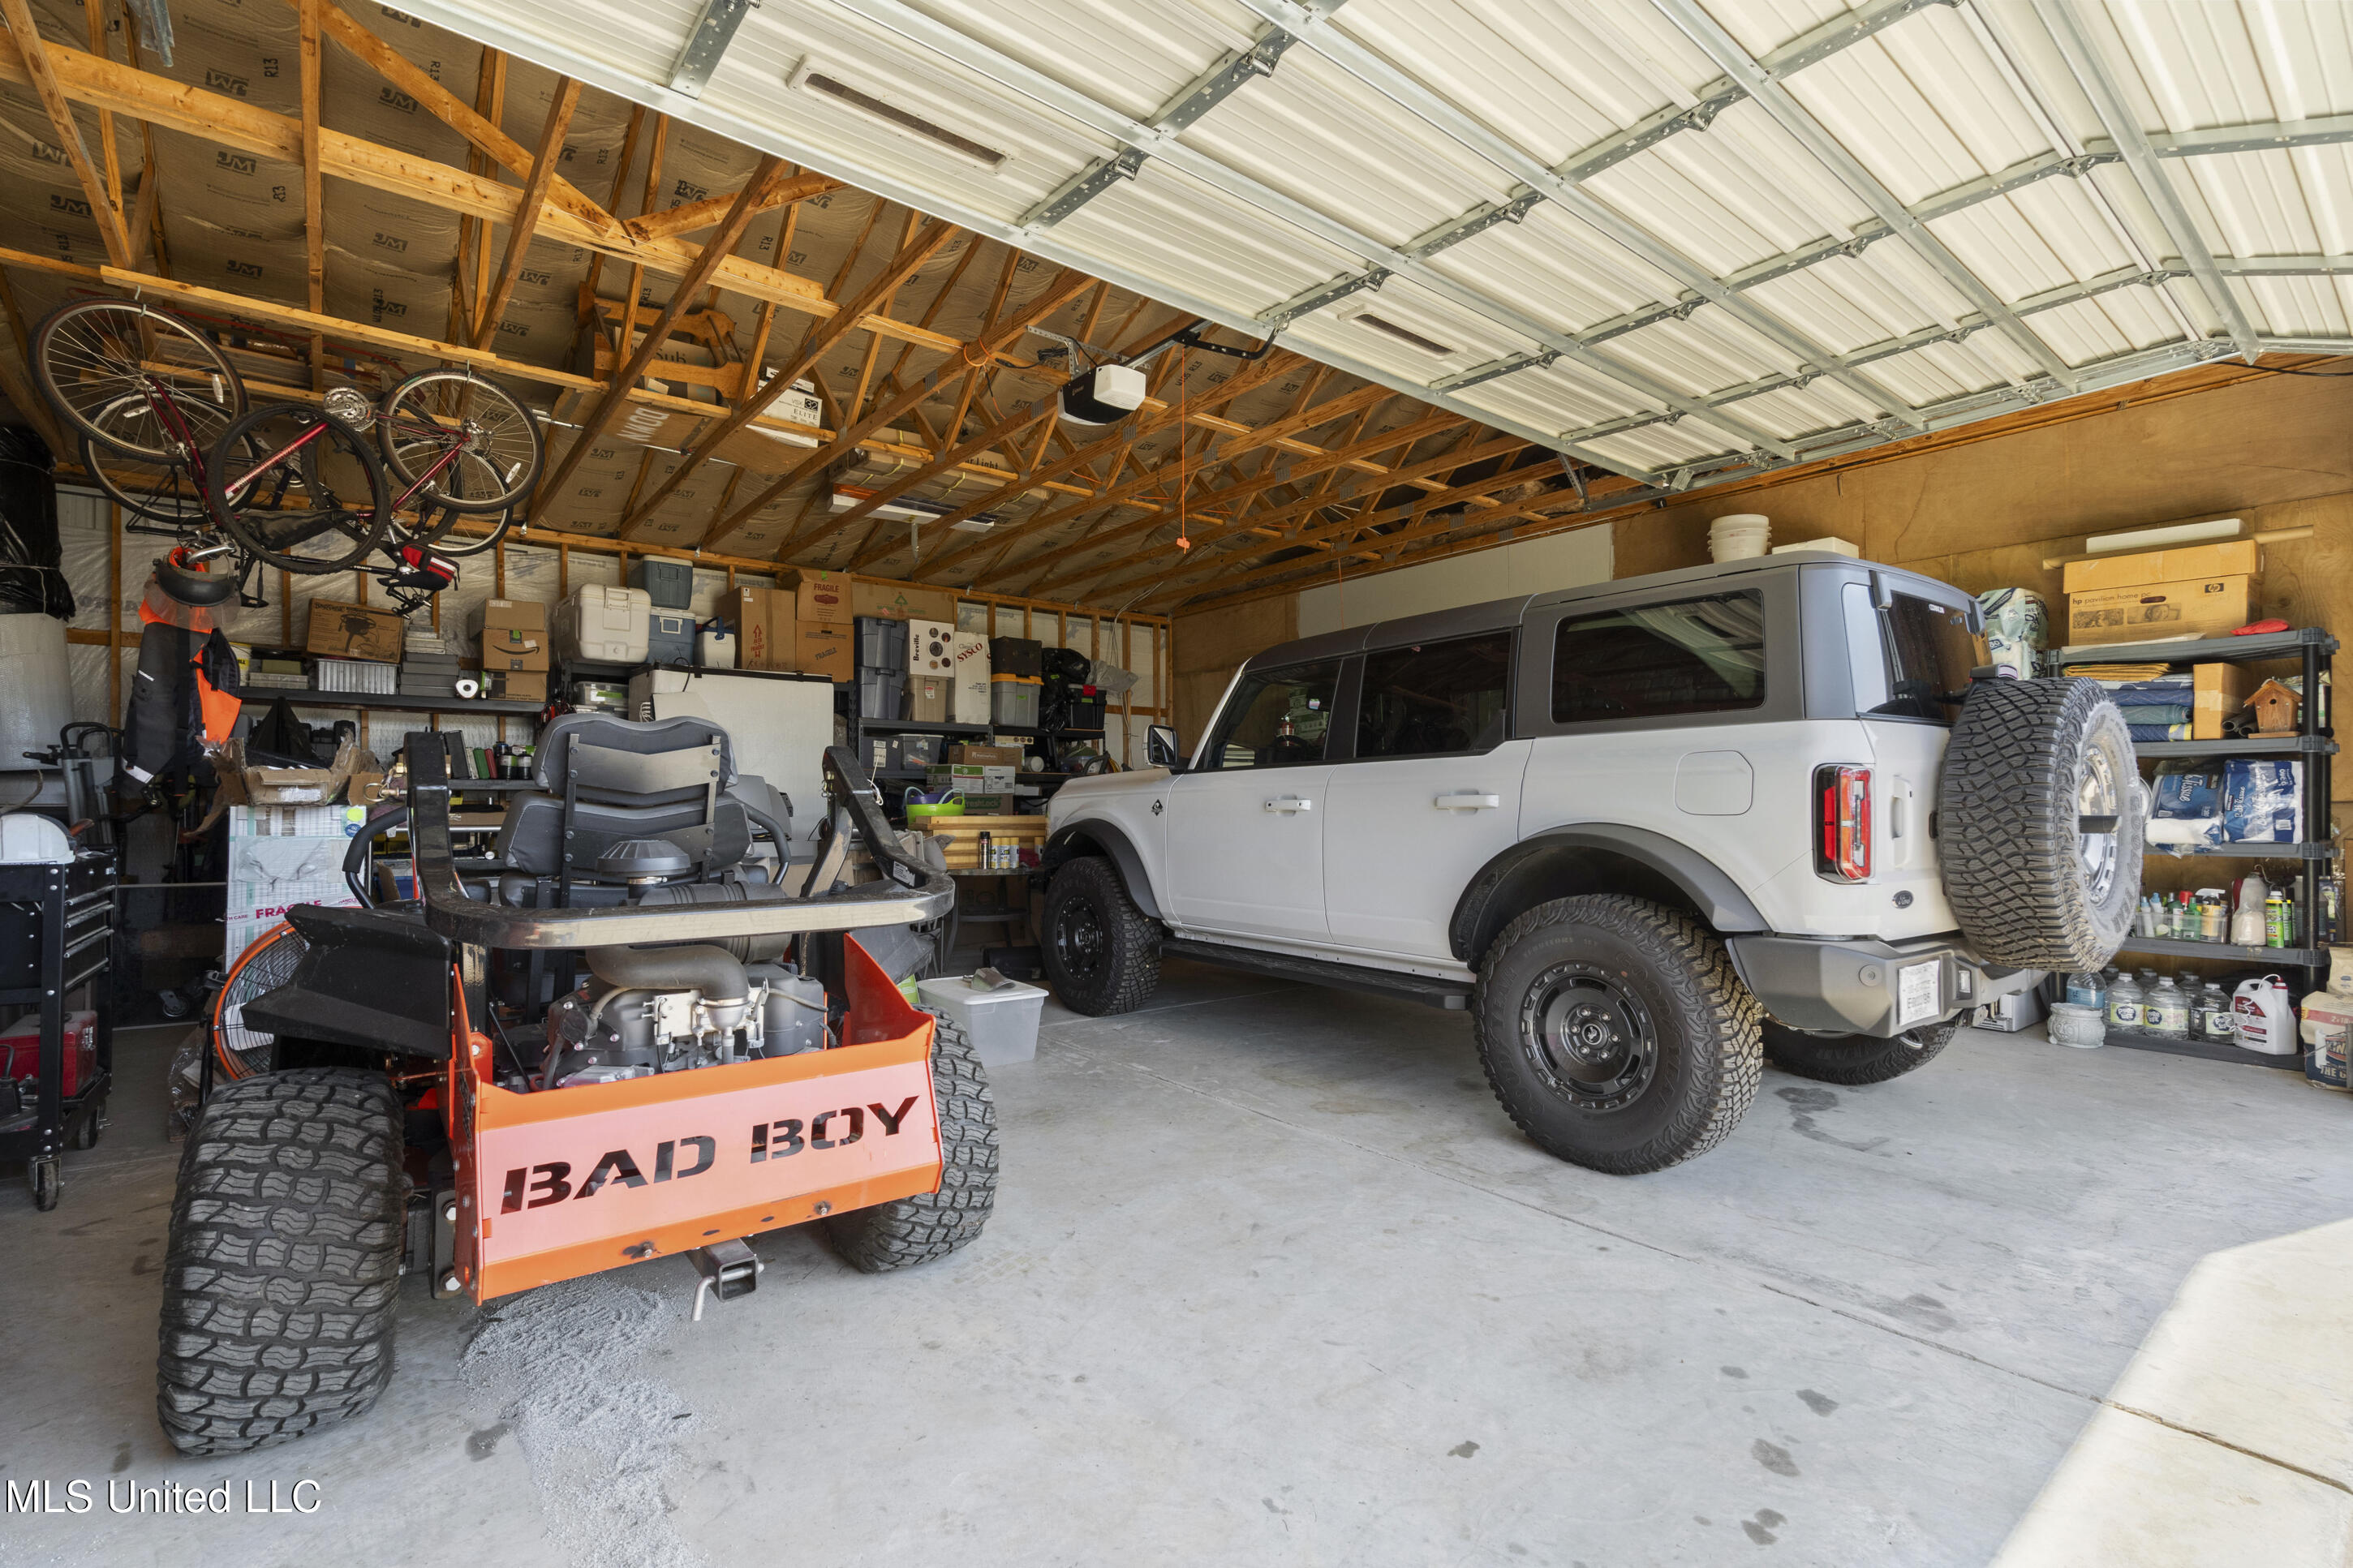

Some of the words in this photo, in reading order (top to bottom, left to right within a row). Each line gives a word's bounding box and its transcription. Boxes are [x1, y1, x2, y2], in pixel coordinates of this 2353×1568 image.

[264, 58, 279, 78] R13
[205, 69, 248, 96] JM
[379, 87, 419, 112] JM
[216, 151, 256, 172] JM
[50, 195, 91, 217] JM
[372, 232, 408, 251] JM
[759, 235, 773, 251] R13
[226, 260, 263, 277] JM
[518, 271, 552, 285] JM
[500, 321, 530, 337] JM
[805, 398, 819, 411] 32
[794, 409, 818, 420] ELITE
[590, 448, 614, 460] JM
[814, 582, 839, 593] FRAGILE
[2084, 595, 2114, 604] pavilion
[815, 647, 837, 659] FRAGILE
[957, 642, 983, 662] SYSCO
[2179, 779, 2204, 802] Tissue
[500, 1135, 716, 1215] BAD
[751, 1095, 919, 1165] BOY
